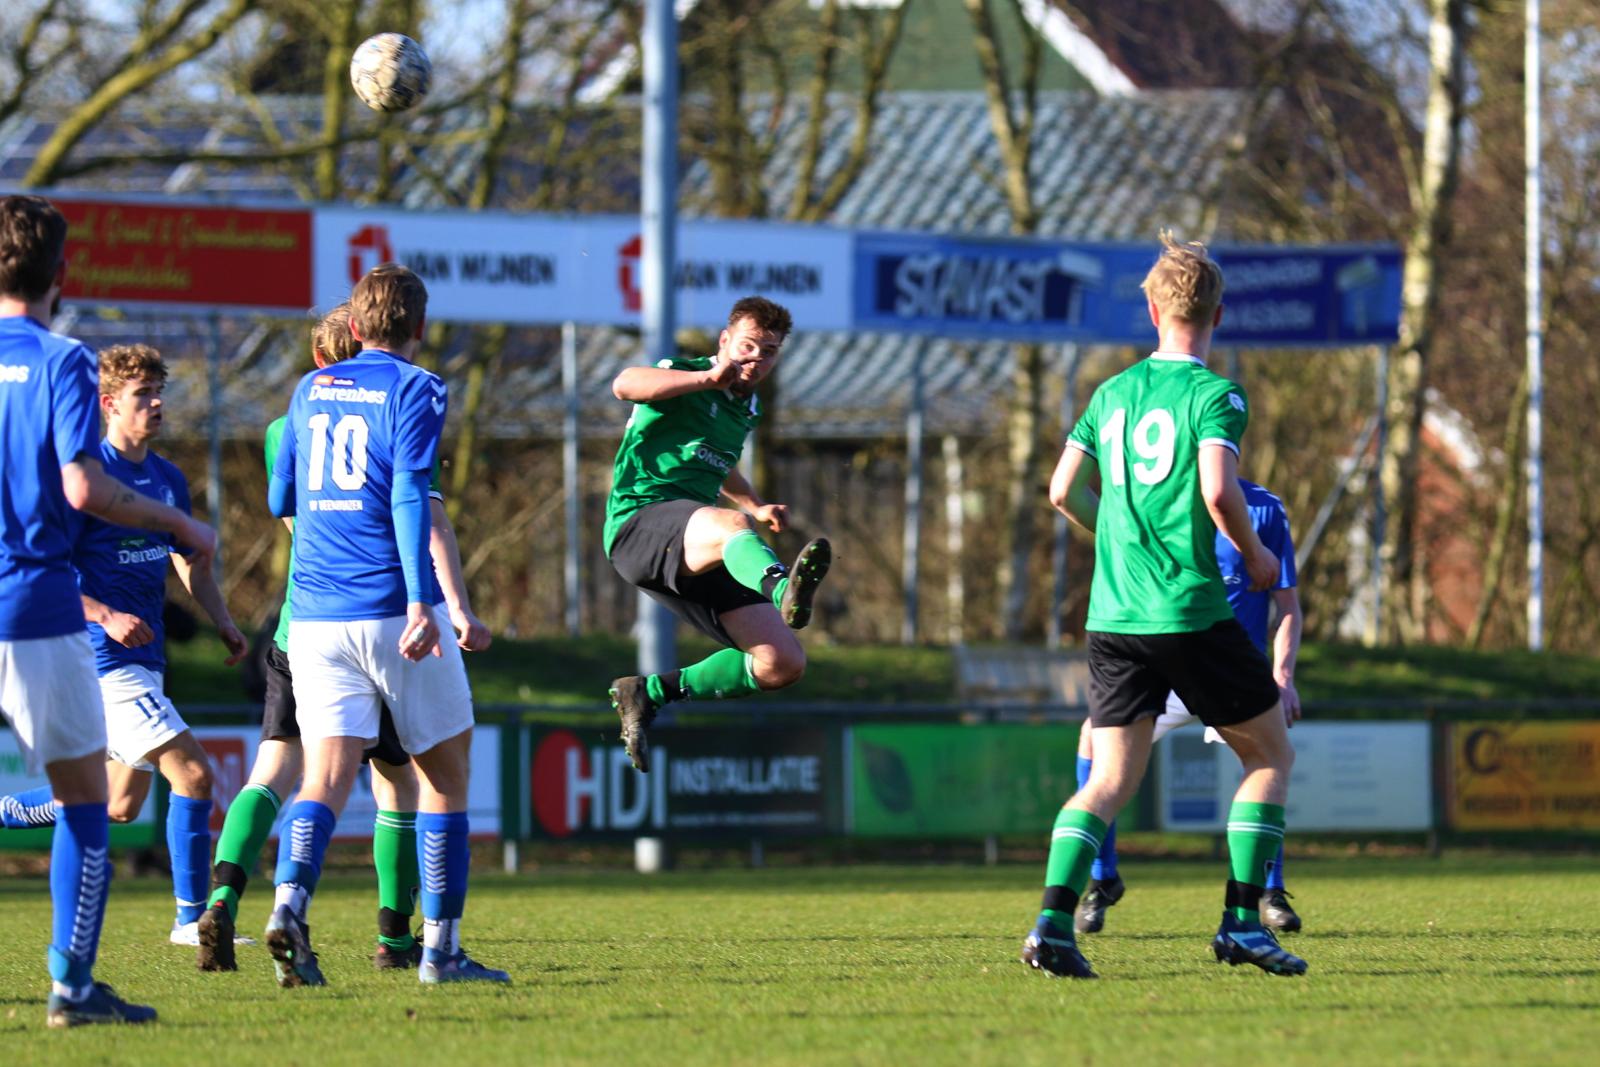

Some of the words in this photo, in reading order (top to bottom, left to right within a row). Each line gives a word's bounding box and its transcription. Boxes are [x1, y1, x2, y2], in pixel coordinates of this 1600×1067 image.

[459, 252, 555, 285] WIJNEN
[728, 264, 820, 294] WIJNEN
[308, 413, 368, 491] 10
[1100, 408, 1175, 486] 19
[566, 747, 667, 829] HDI
